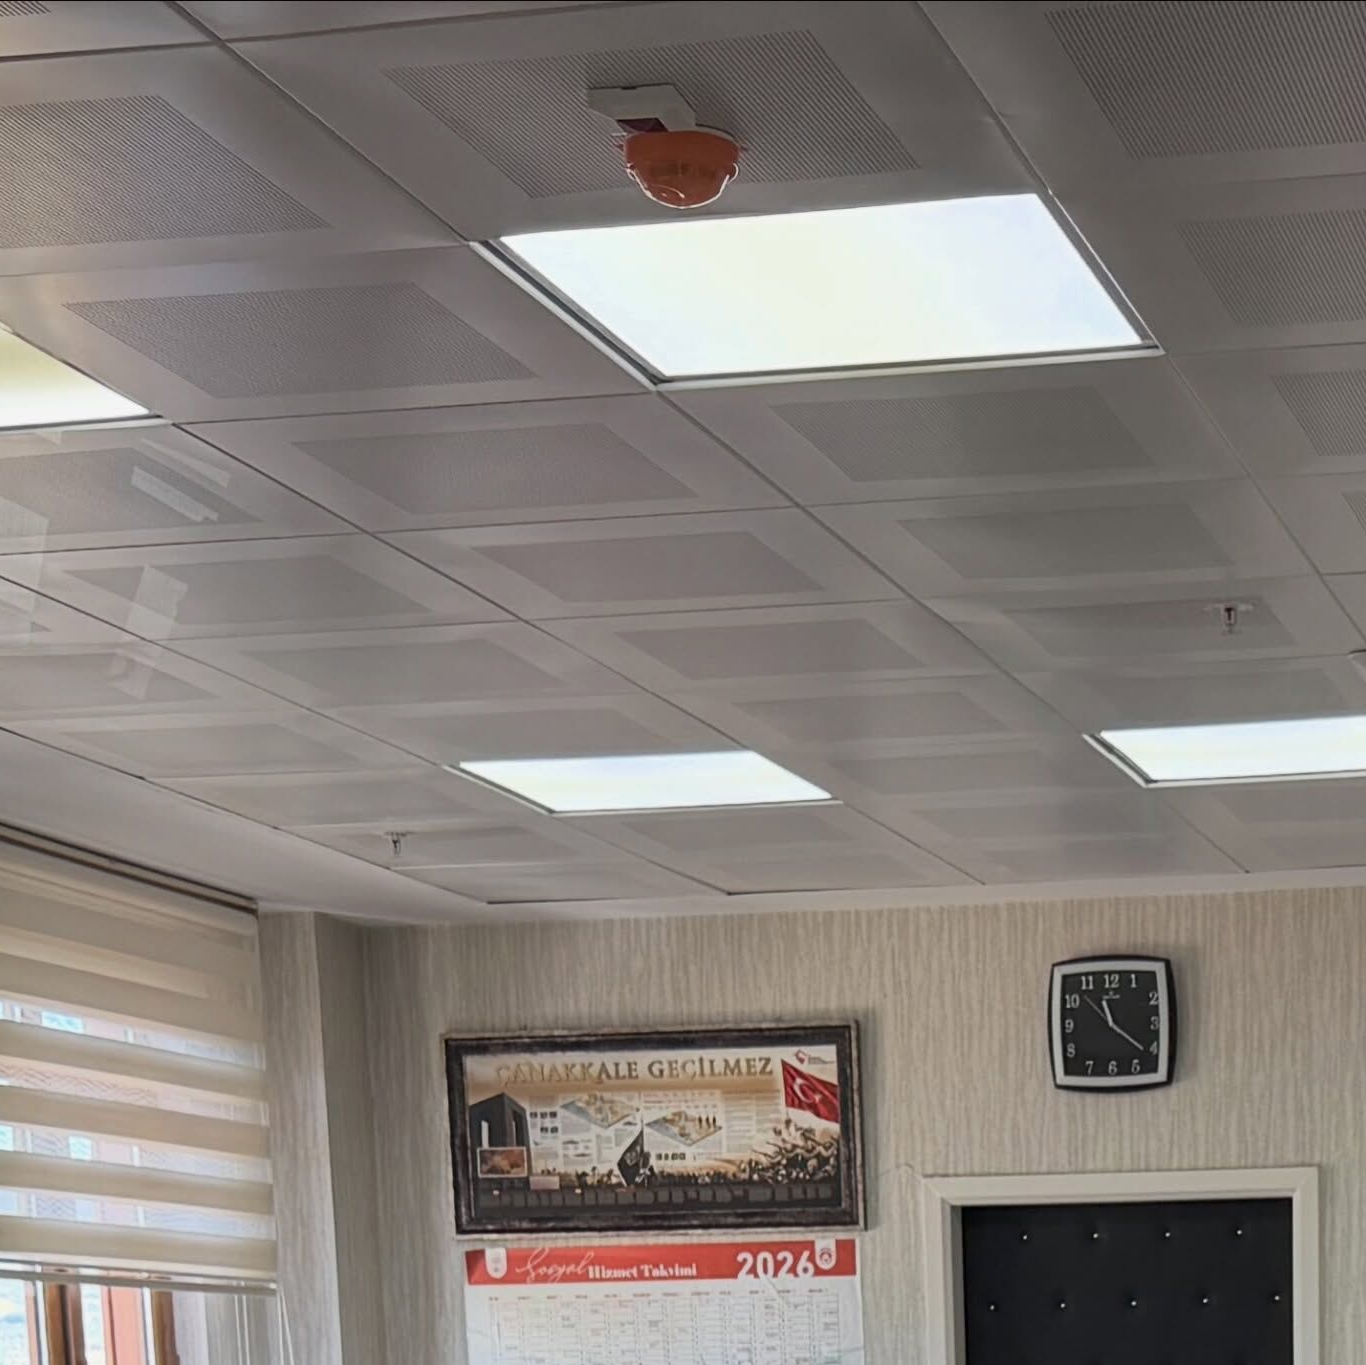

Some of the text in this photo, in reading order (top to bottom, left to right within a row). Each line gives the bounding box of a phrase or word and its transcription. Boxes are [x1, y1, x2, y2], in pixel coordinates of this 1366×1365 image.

[1081, 975, 1094, 991] 11
[1103, 973, 1120, 989] 12
[1130, 973, 1137, 989] 1
[1065, 993, 1080, 1009] 10
[1148, 991, 1159, 1006] 2
[1065, 1018, 1074, 1033] 9
[1150, 1015, 1160, 1031] 3
[1066, 1042, 1076, 1058] 8
[1149, 1040, 1158, 1056] 4
[495, 1059, 639, 1086] ÇANAKKALE
[647, 1055, 774, 1082] GEÇİLMEZ
[1084, 1060, 1094, 1075] 7
[1107, 1060, 1118, 1076] 6
[1131, 1058, 1141, 1074] 5
[587, 1264, 638, 1280] Hizmet
[640, 1262, 697, 1279] Takvimi
[736, 1250, 815, 1281] 2026
